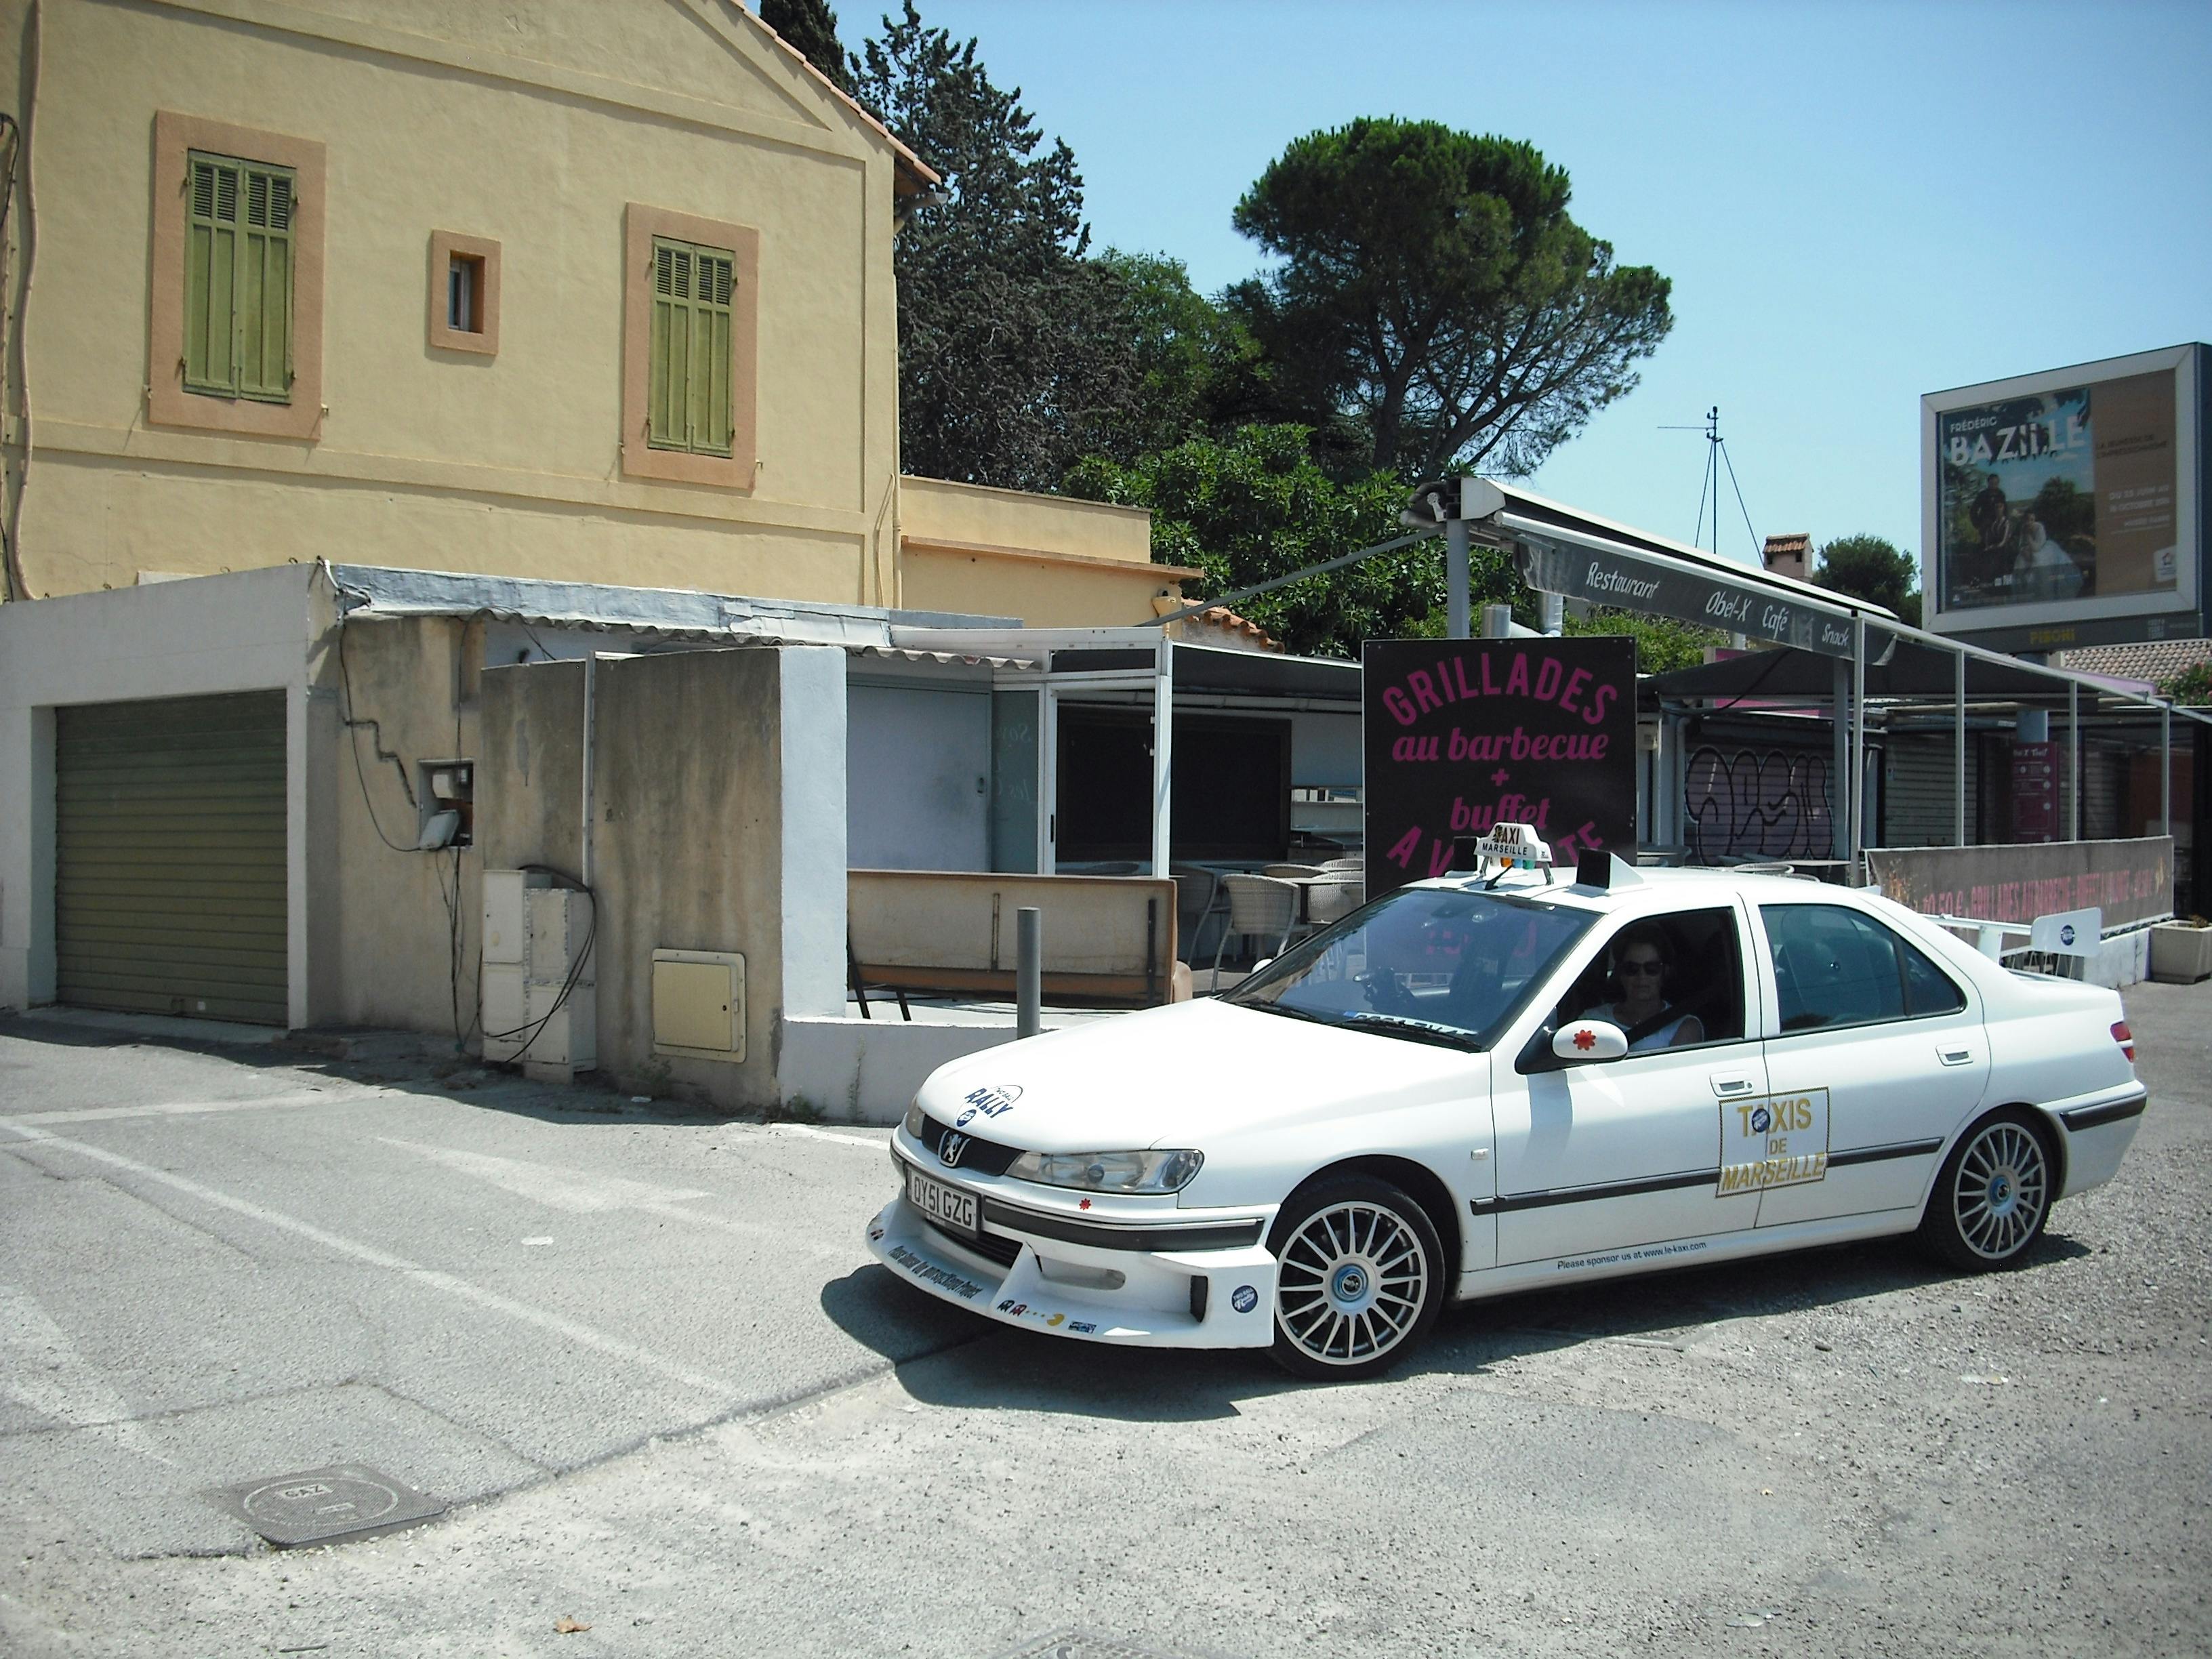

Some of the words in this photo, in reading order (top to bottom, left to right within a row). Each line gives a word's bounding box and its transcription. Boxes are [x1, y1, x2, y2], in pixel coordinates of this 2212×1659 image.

[1950, 415, 1998, 433] FRÉDÉRIC
[1586, 560, 1660, 600] Restaurant
[1705, 590, 1753, 622] Obel-X
[1761, 604, 1790, 640] Café
[1822, 623, 1850, 647] Snack
[1382, 652, 1618, 726] GRILLADES
[1392, 735, 1439, 762] au
[1448, 726, 1609, 762] barbecue
[1490, 768, 1510, 787] +
[1450, 794, 1551, 832] buffet
[1482, 842, 1528, 856] MARSEILLE
[964, 1088, 1014, 1119] RALLY
[1769, 1138, 1787, 1155] DE
[1721, 1151, 1826, 1191] MARSEILLE
[943, 1190, 972, 1227] GZG
[1557, 1260, 1584, 1271] Please
[1586, 1254, 1619, 1268] sponsor
[1621, 1252, 1631, 1261] us
[1633, 1251, 1642, 1259] at
